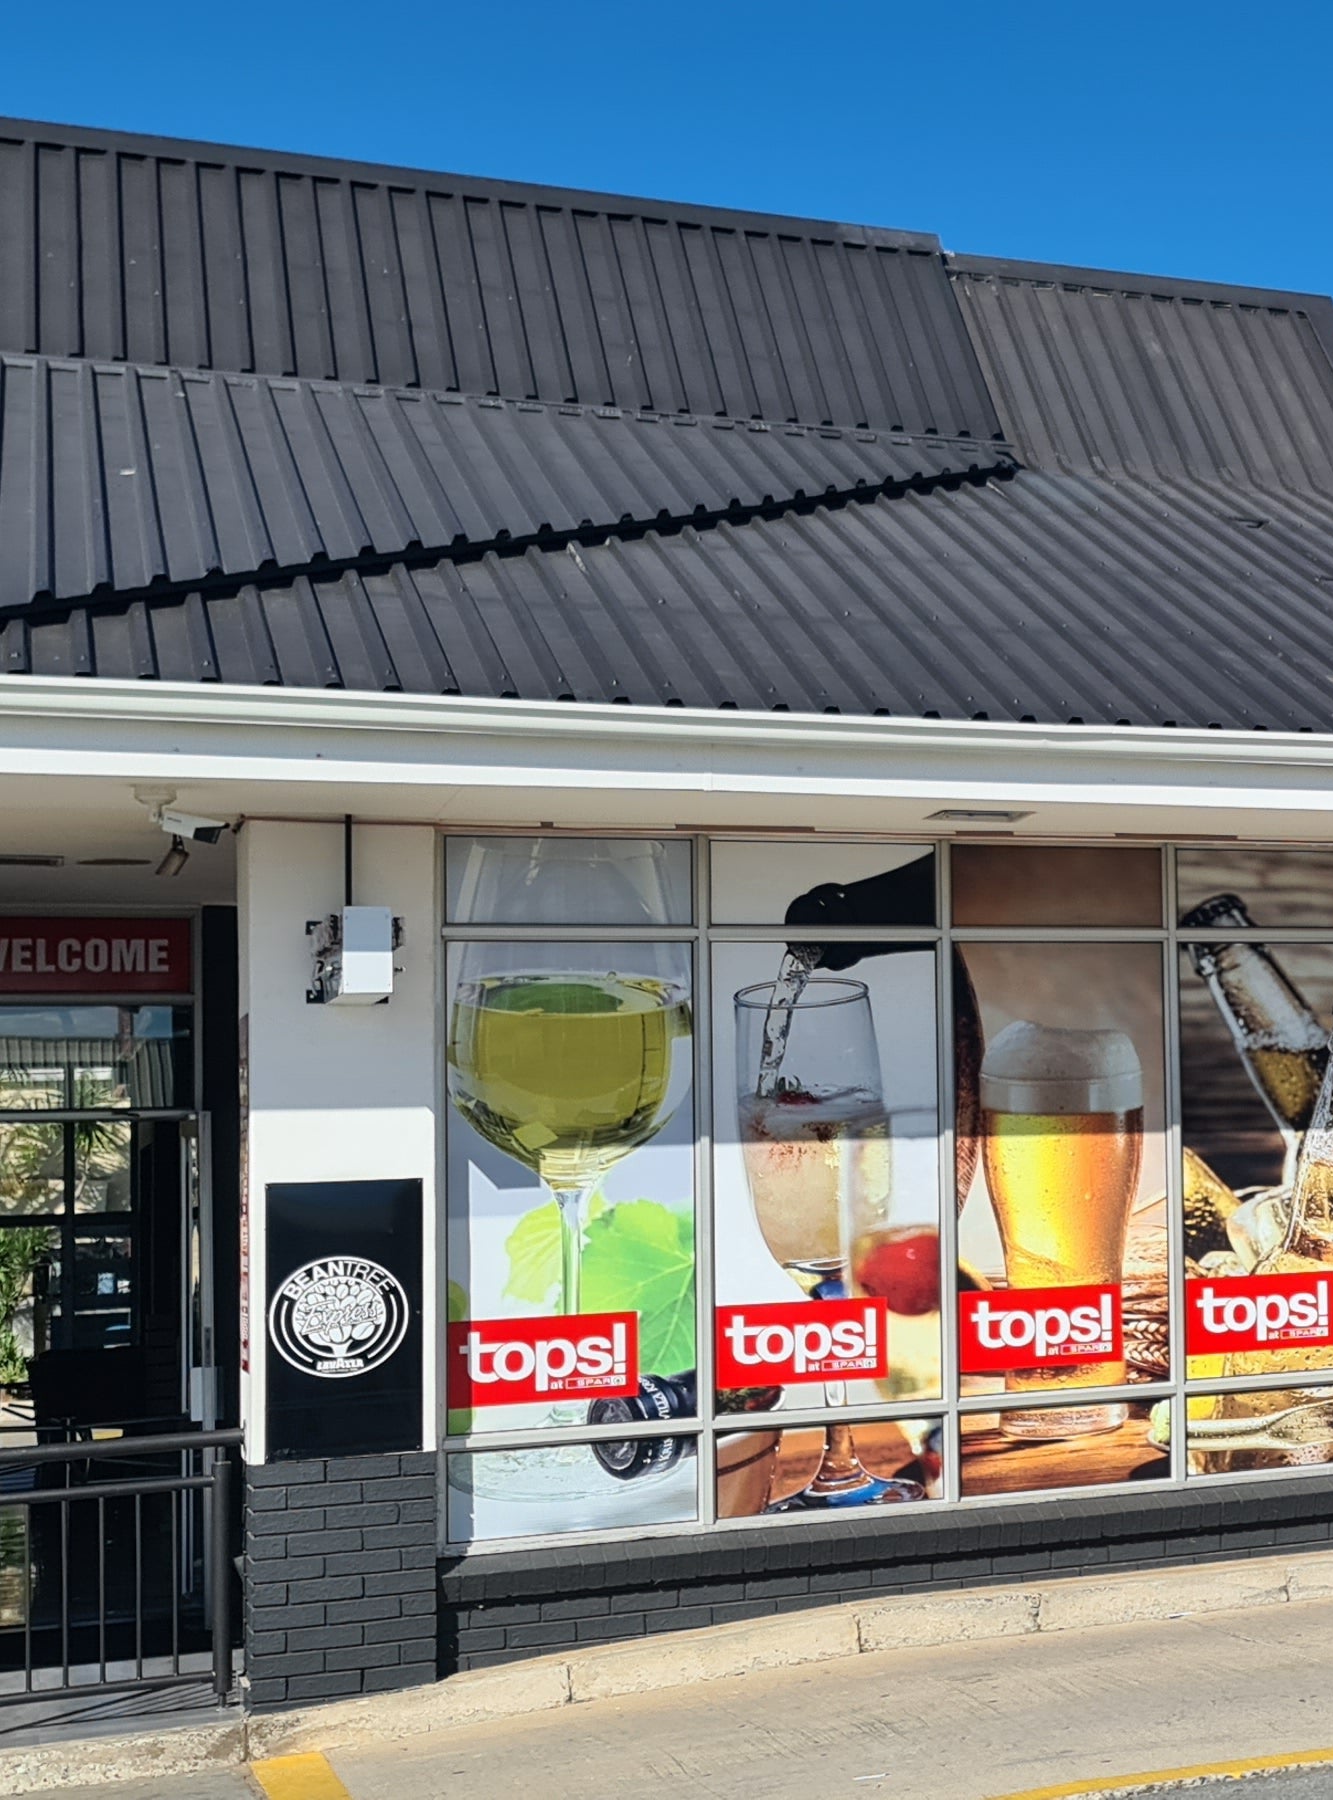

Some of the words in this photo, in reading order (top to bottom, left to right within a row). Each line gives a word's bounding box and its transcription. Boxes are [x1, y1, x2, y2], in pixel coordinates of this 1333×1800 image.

[0, 937, 170, 973] ELCOME
[282, 1260, 396, 1301] BEANTREE
[1196, 1280, 1329, 1341] tops!
[724, 1308, 877, 1374] tops!
[971, 1293, 1113, 1357] tops!
[459, 1322, 627, 1392] tops!
